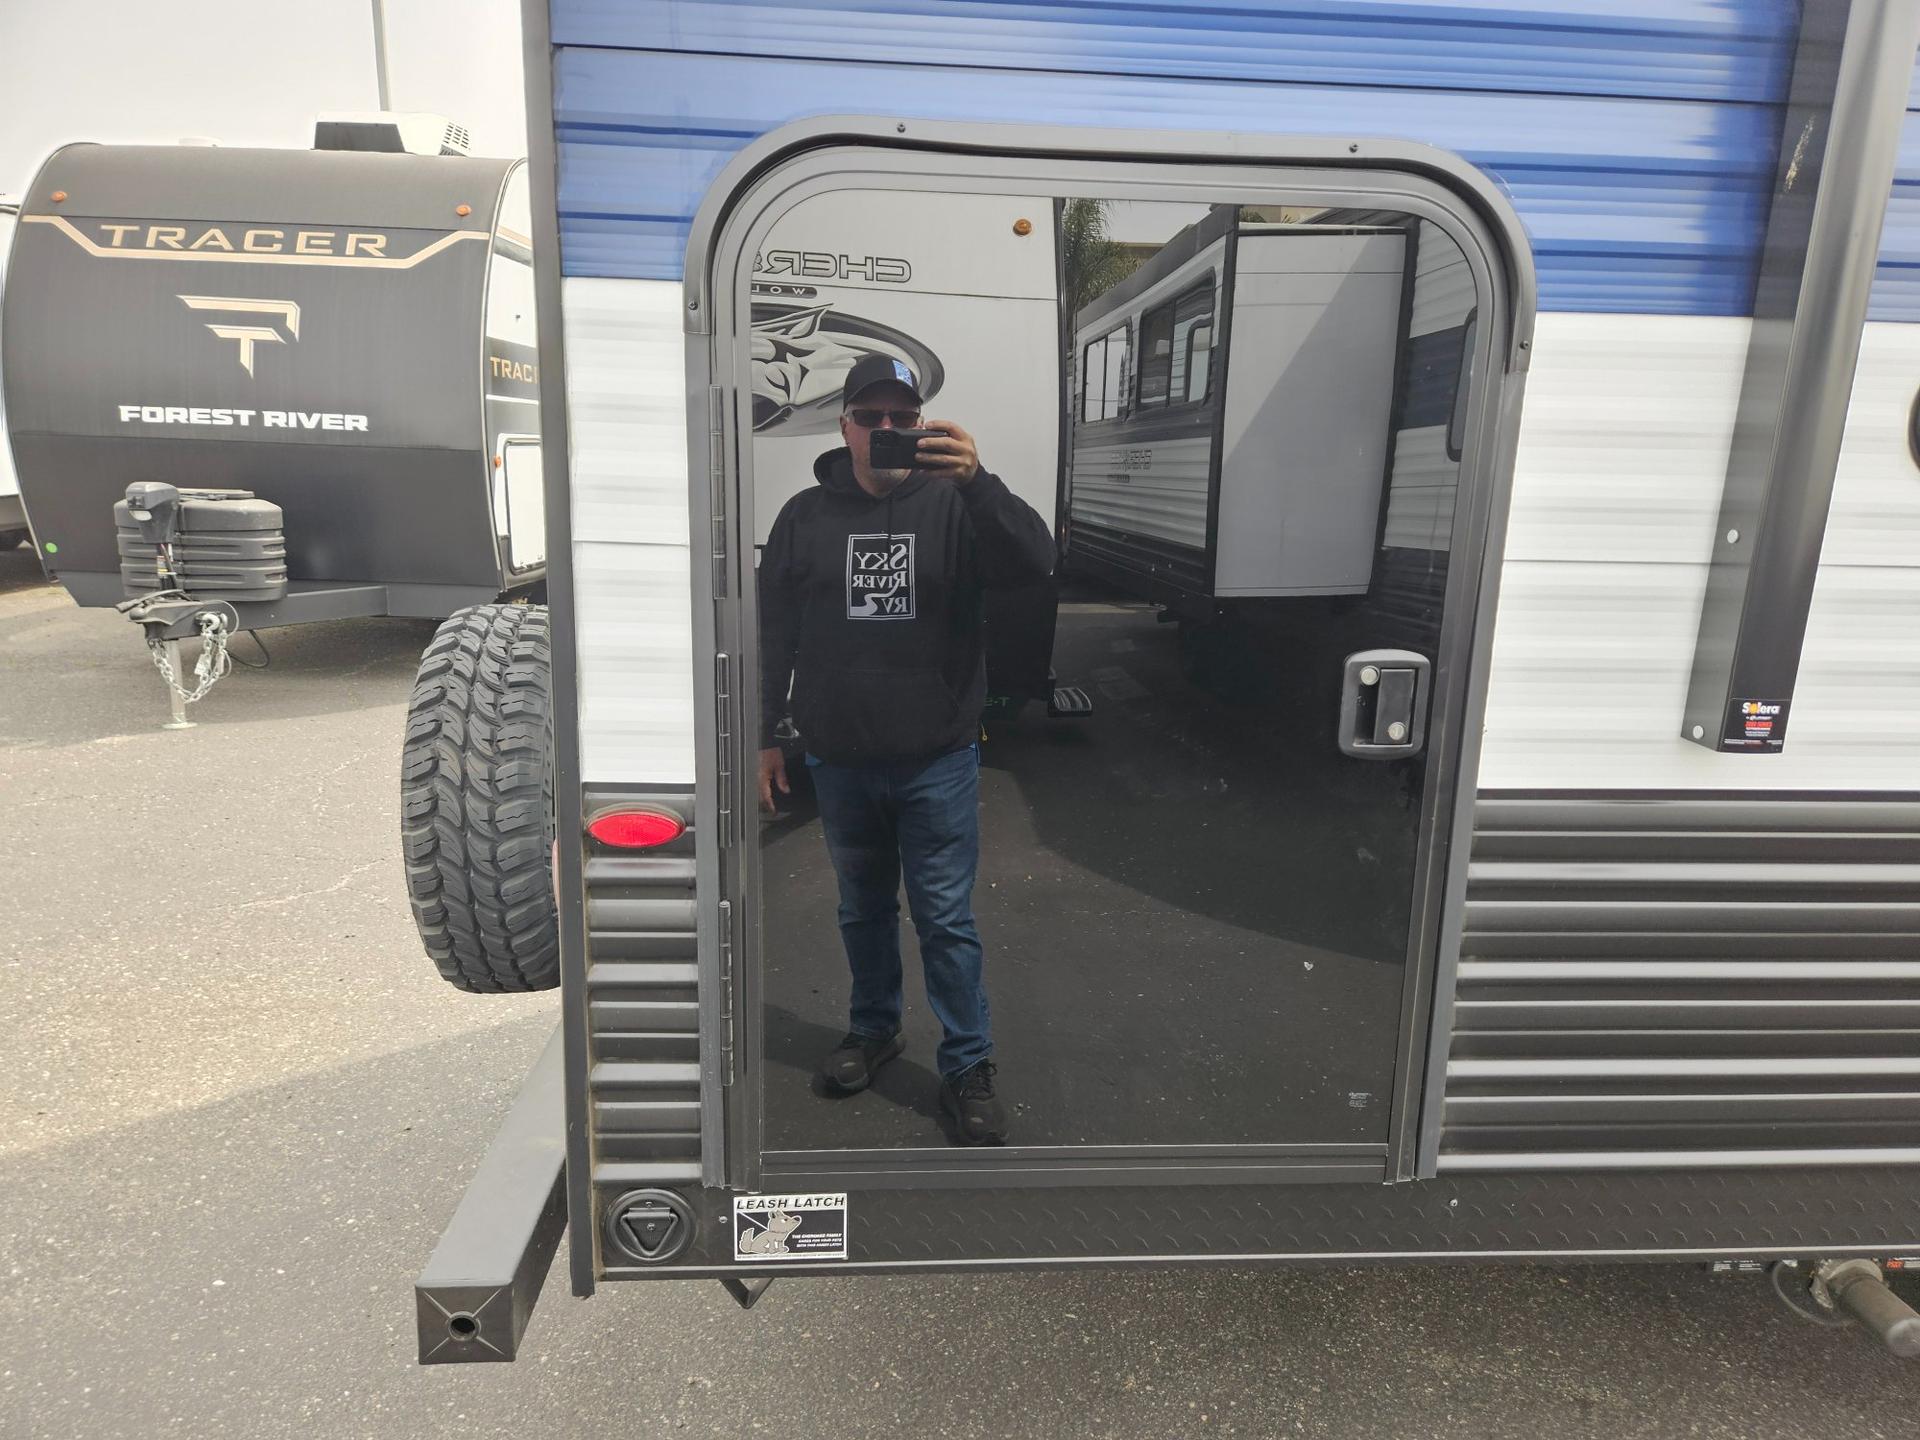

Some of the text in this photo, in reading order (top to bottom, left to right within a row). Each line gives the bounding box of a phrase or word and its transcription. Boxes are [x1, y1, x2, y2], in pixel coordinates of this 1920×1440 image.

[100, 224, 387, 257] TRACER
[490, 356, 538, 385] TRAC
[118, 405, 369, 431] FOREST RIVER
[1741, 701, 1781, 715] Solera
[736, 1197, 844, 1209] LEASH LATCH
